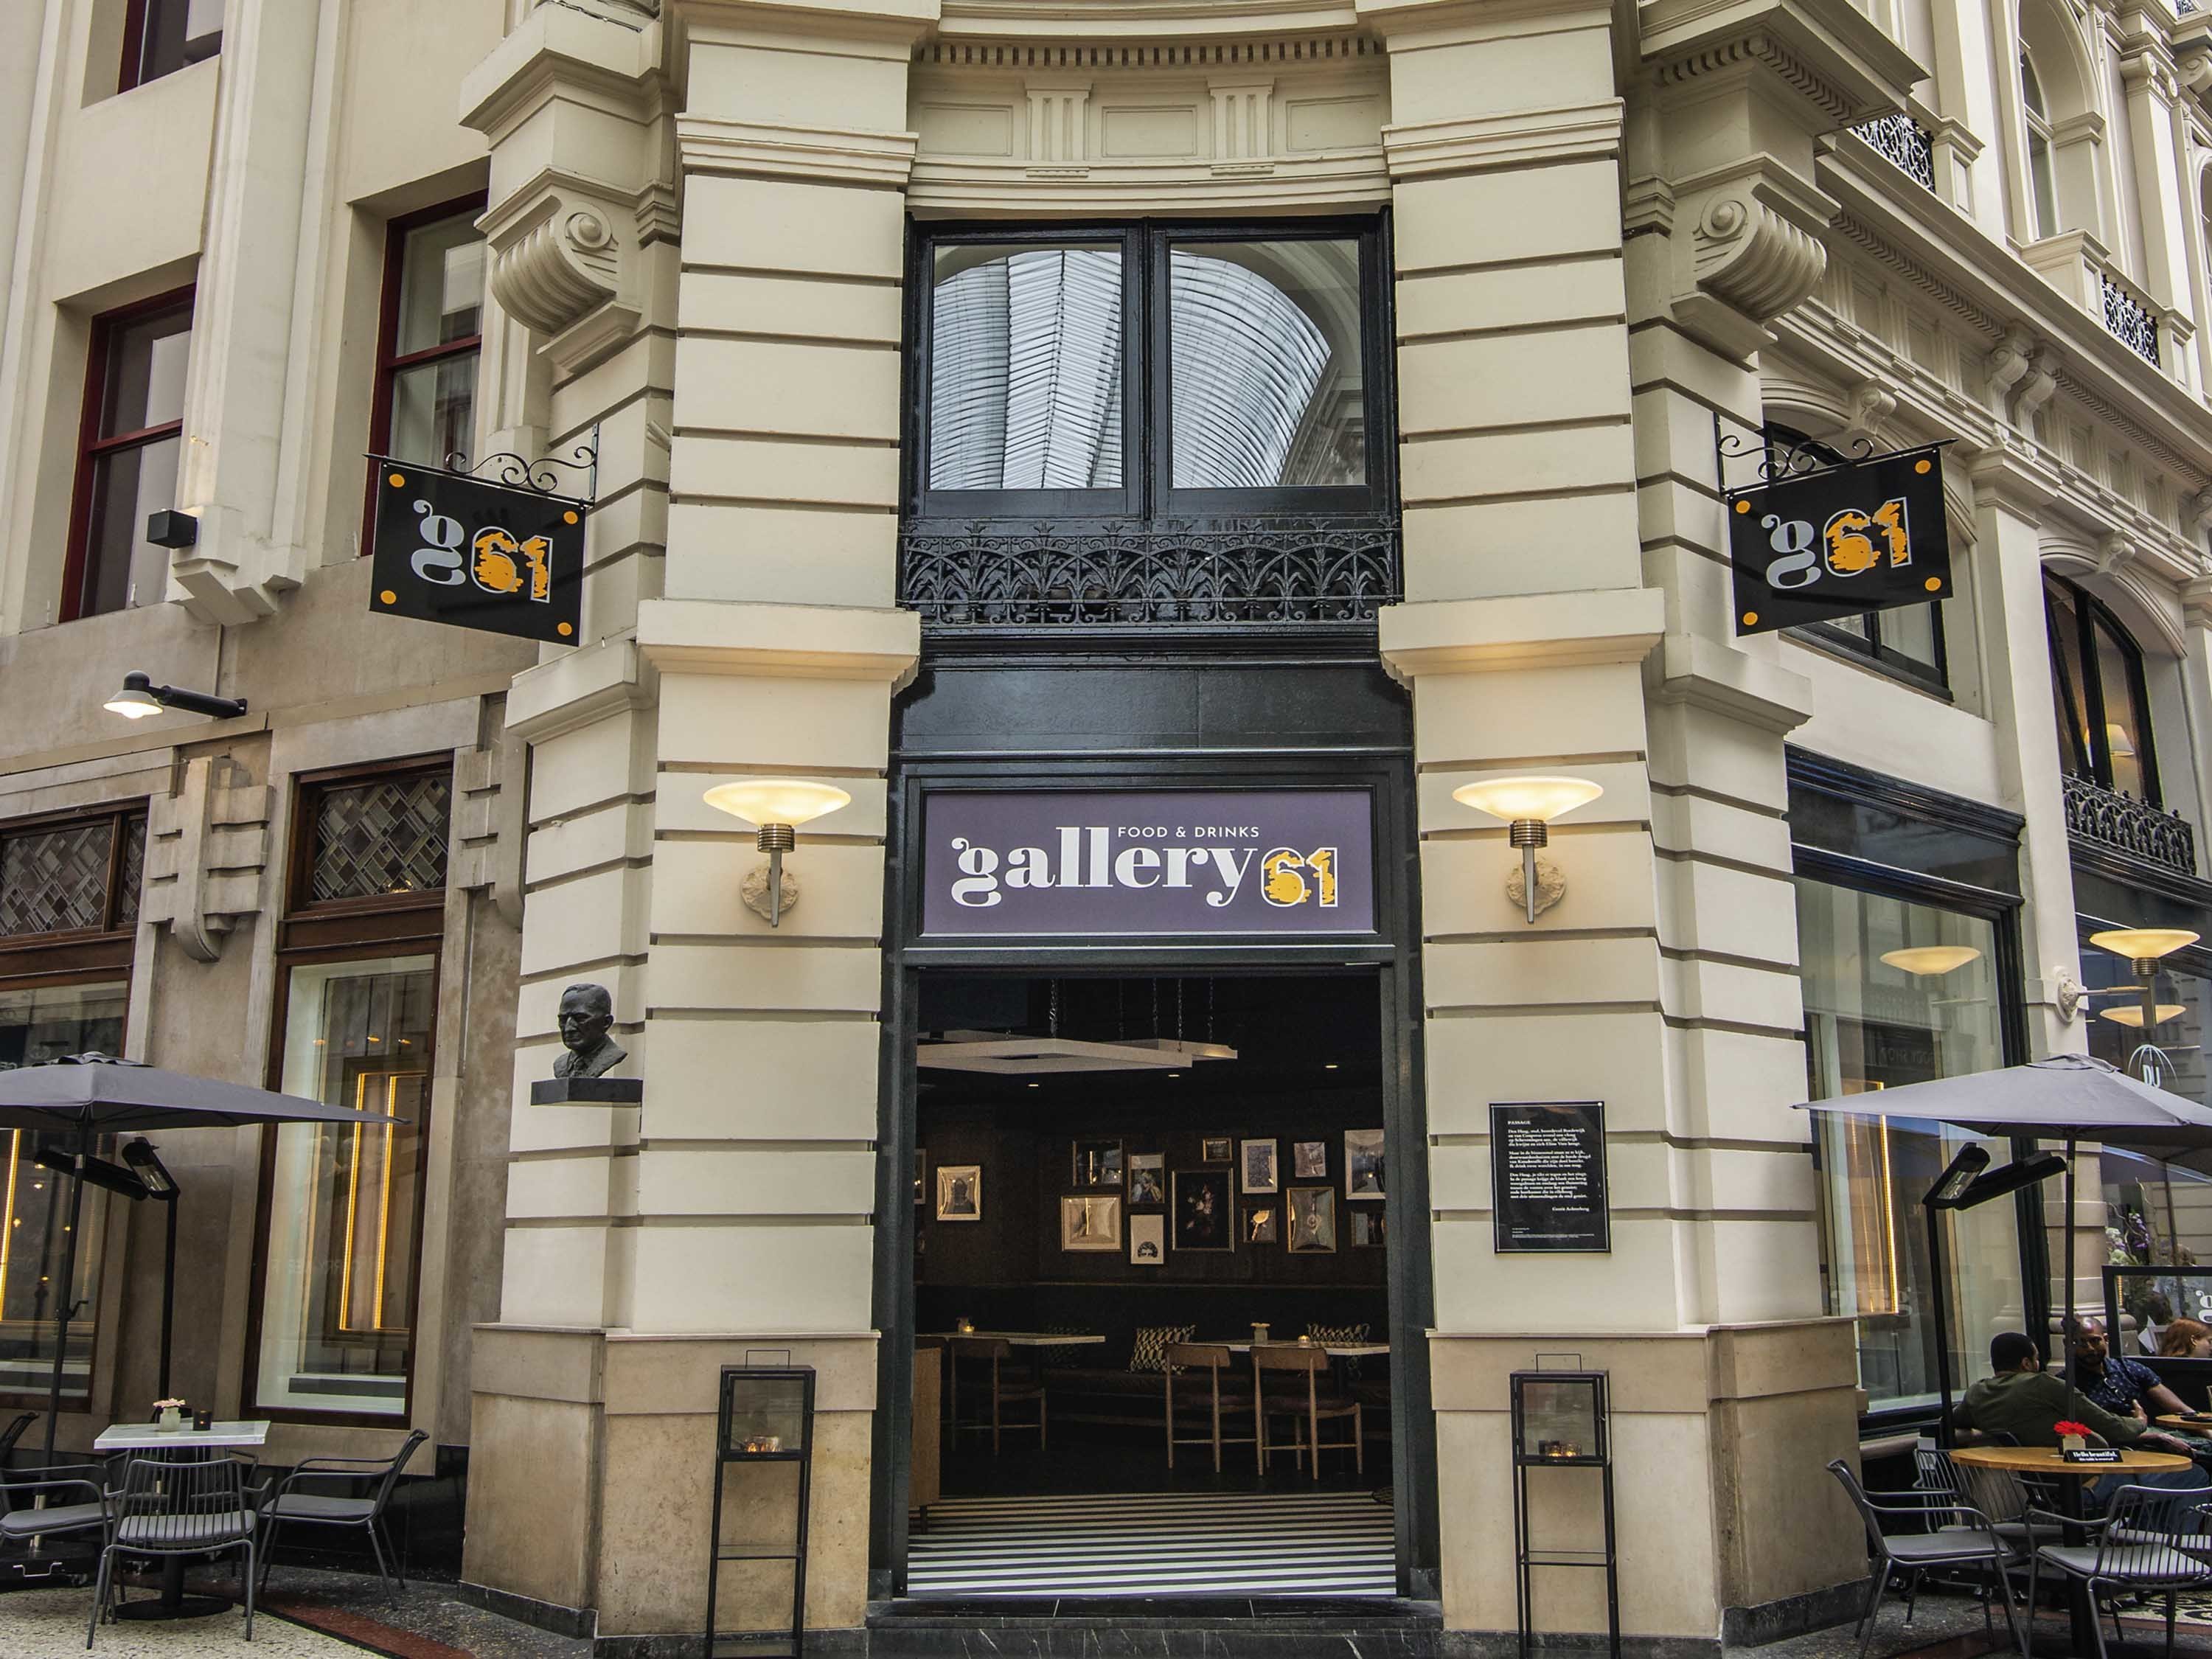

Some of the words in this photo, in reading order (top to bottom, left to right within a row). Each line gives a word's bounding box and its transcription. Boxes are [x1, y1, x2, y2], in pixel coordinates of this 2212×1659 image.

[1118, 827, 1168, 838] FOOD
[1176, 827, 1186, 838] &
[1194, 827, 1259, 838] DRINKS
